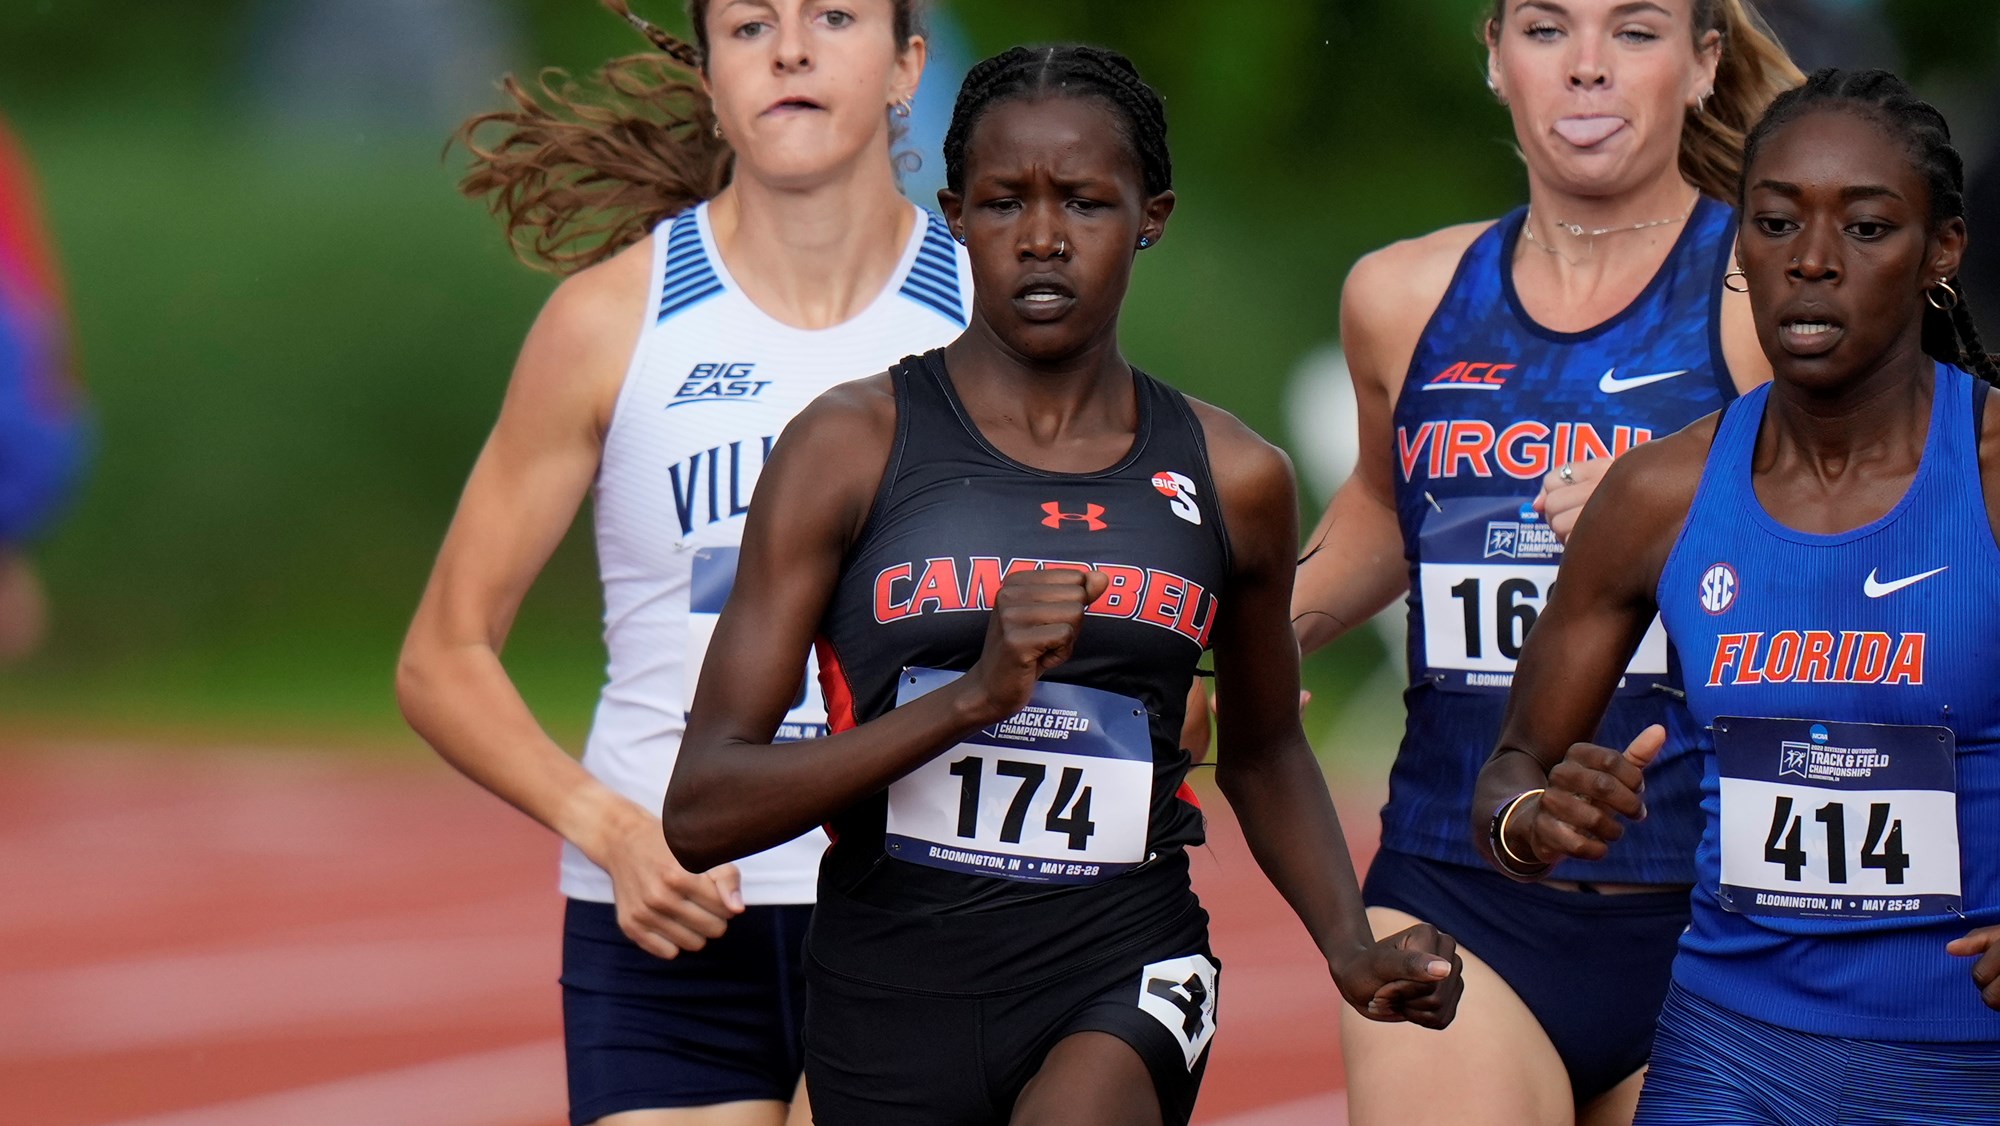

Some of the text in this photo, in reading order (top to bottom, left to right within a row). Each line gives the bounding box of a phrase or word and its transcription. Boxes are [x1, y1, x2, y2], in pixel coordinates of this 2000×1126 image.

[687, 363, 756, 379] BIG
[1431, 361, 1517, 384] ACC
[674, 381, 774, 397] EAST
[1398, 420, 1652, 483] VIRGIN
[668, 436, 774, 537] VIL
[1520, 530, 1557, 543] TRACK
[873, 556, 1219, 648] CAMBEL
[1701, 566, 1735, 612] SEC
[1451, 578, 1557, 661] 16
[1705, 630, 1926, 687] FLORIDA
[999, 724, 1069, 740] CHAMPIONSHIPS
[1002, 713, 1089, 732] RACK & FIELD
[1809, 764, 1871, 777] CHAMPIONSHIPS
[1811, 751, 1889, 767] TRACK & FIELD
[950, 755, 1095, 851] 174
[1764, 796, 1910, 885] 414
[929, 846, 1006, 870] BLOOMINGTON,
[1008, 858, 1020, 870] IN
[1040, 863, 1066, 875] MAY
[1066, 864, 1100, 876] 25-28
[1756, 893, 1920, 911] BLOOMINGTON, IN MAY 25-28
[1147, 973, 1207, 1043] 4
